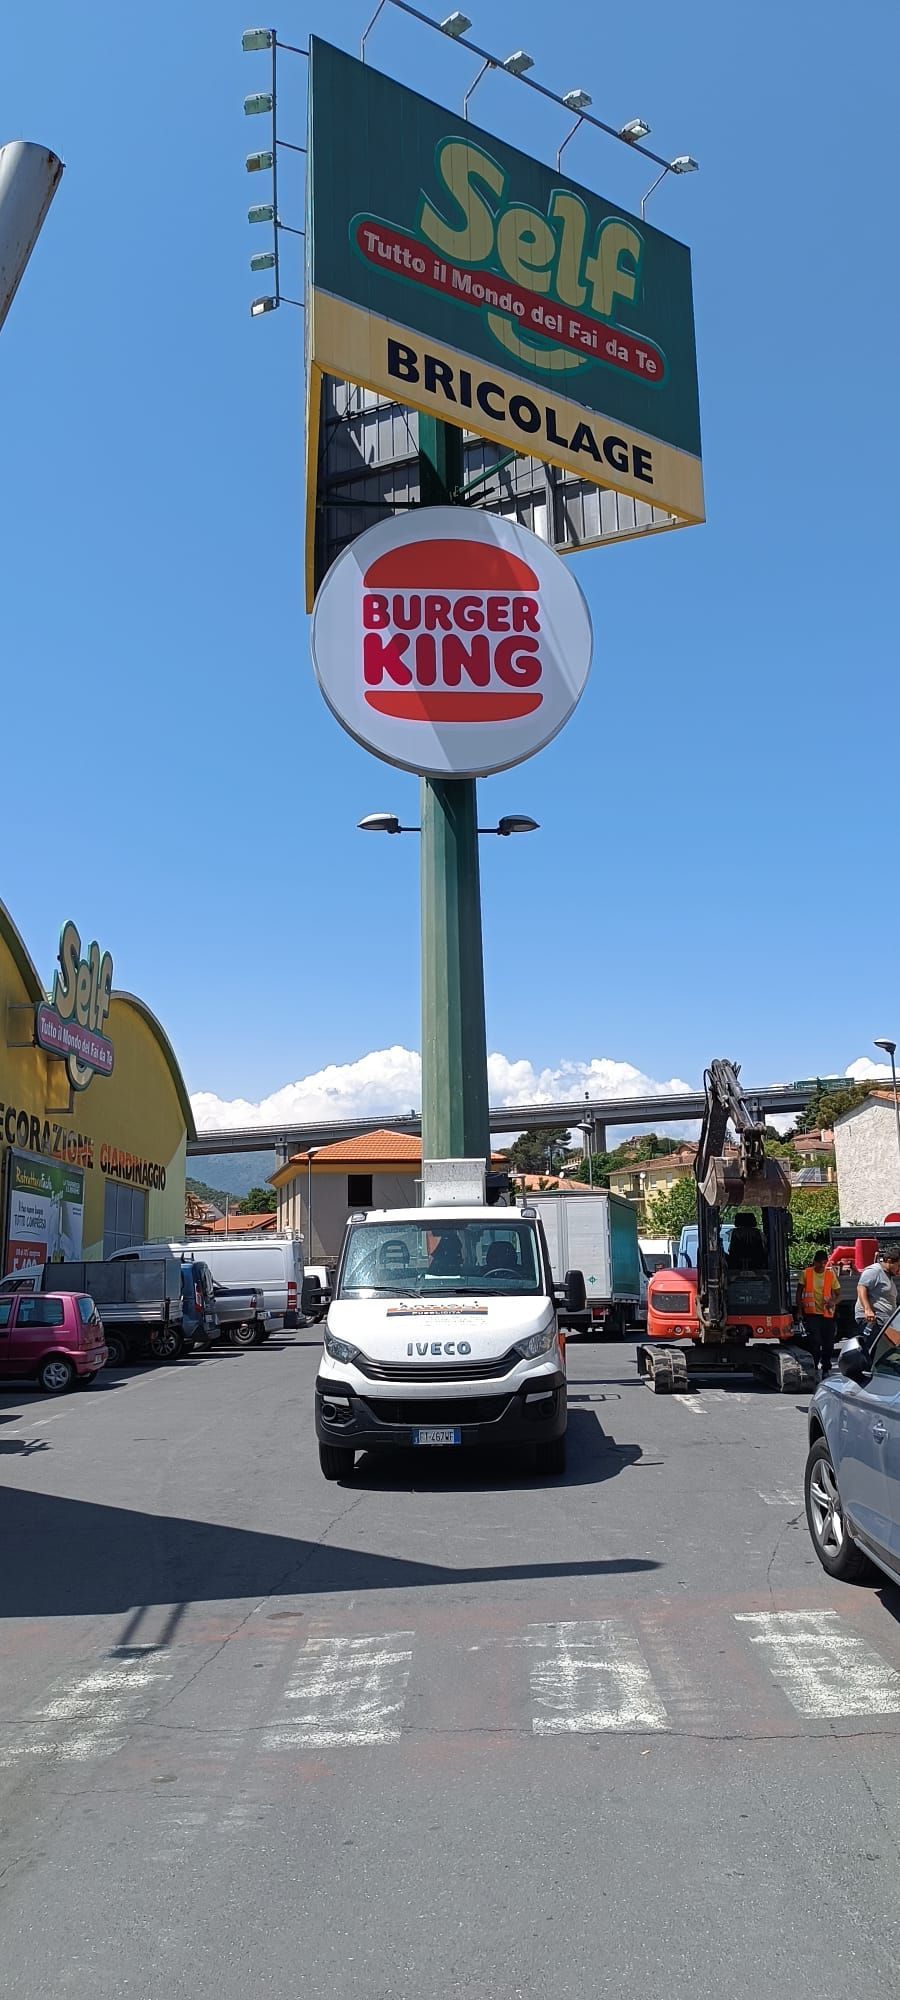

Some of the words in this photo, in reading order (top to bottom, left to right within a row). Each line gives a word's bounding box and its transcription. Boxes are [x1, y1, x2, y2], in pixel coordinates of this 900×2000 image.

[419, 135, 644, 317] Self
[363, 230, 425, 273] Tutto
[433, 260, 448, 283] il
[452, 268, 525, 318] Mondo
[531, 304, 563, 334] del
[568, 321, 598, 348] Fai
[606, 336, 629, 364] da
[635, 350, 657, 374] Te
[386, 338, 654, 484] BRICOLAGE
[362, 594, 541, 633] BURGER
[363, 632, 543, 688] KING
[54, 921, 113, 1030] Self
[41, 1017, 57, 1039] Tutto
[58, 1024, 63, 1041] il
[63, 1028, 82, 1051] Mondo
[82, 1039, 90, 1055] del
[91, 1042, 99, 1058] Fai
[99, 1047, 106, 1062] da
[106, 1049, 113, 1065] Te
[100, 1143, 166, 1191] GIARDINAGGIO
[407, 1341, 472, 1356] IVECO
